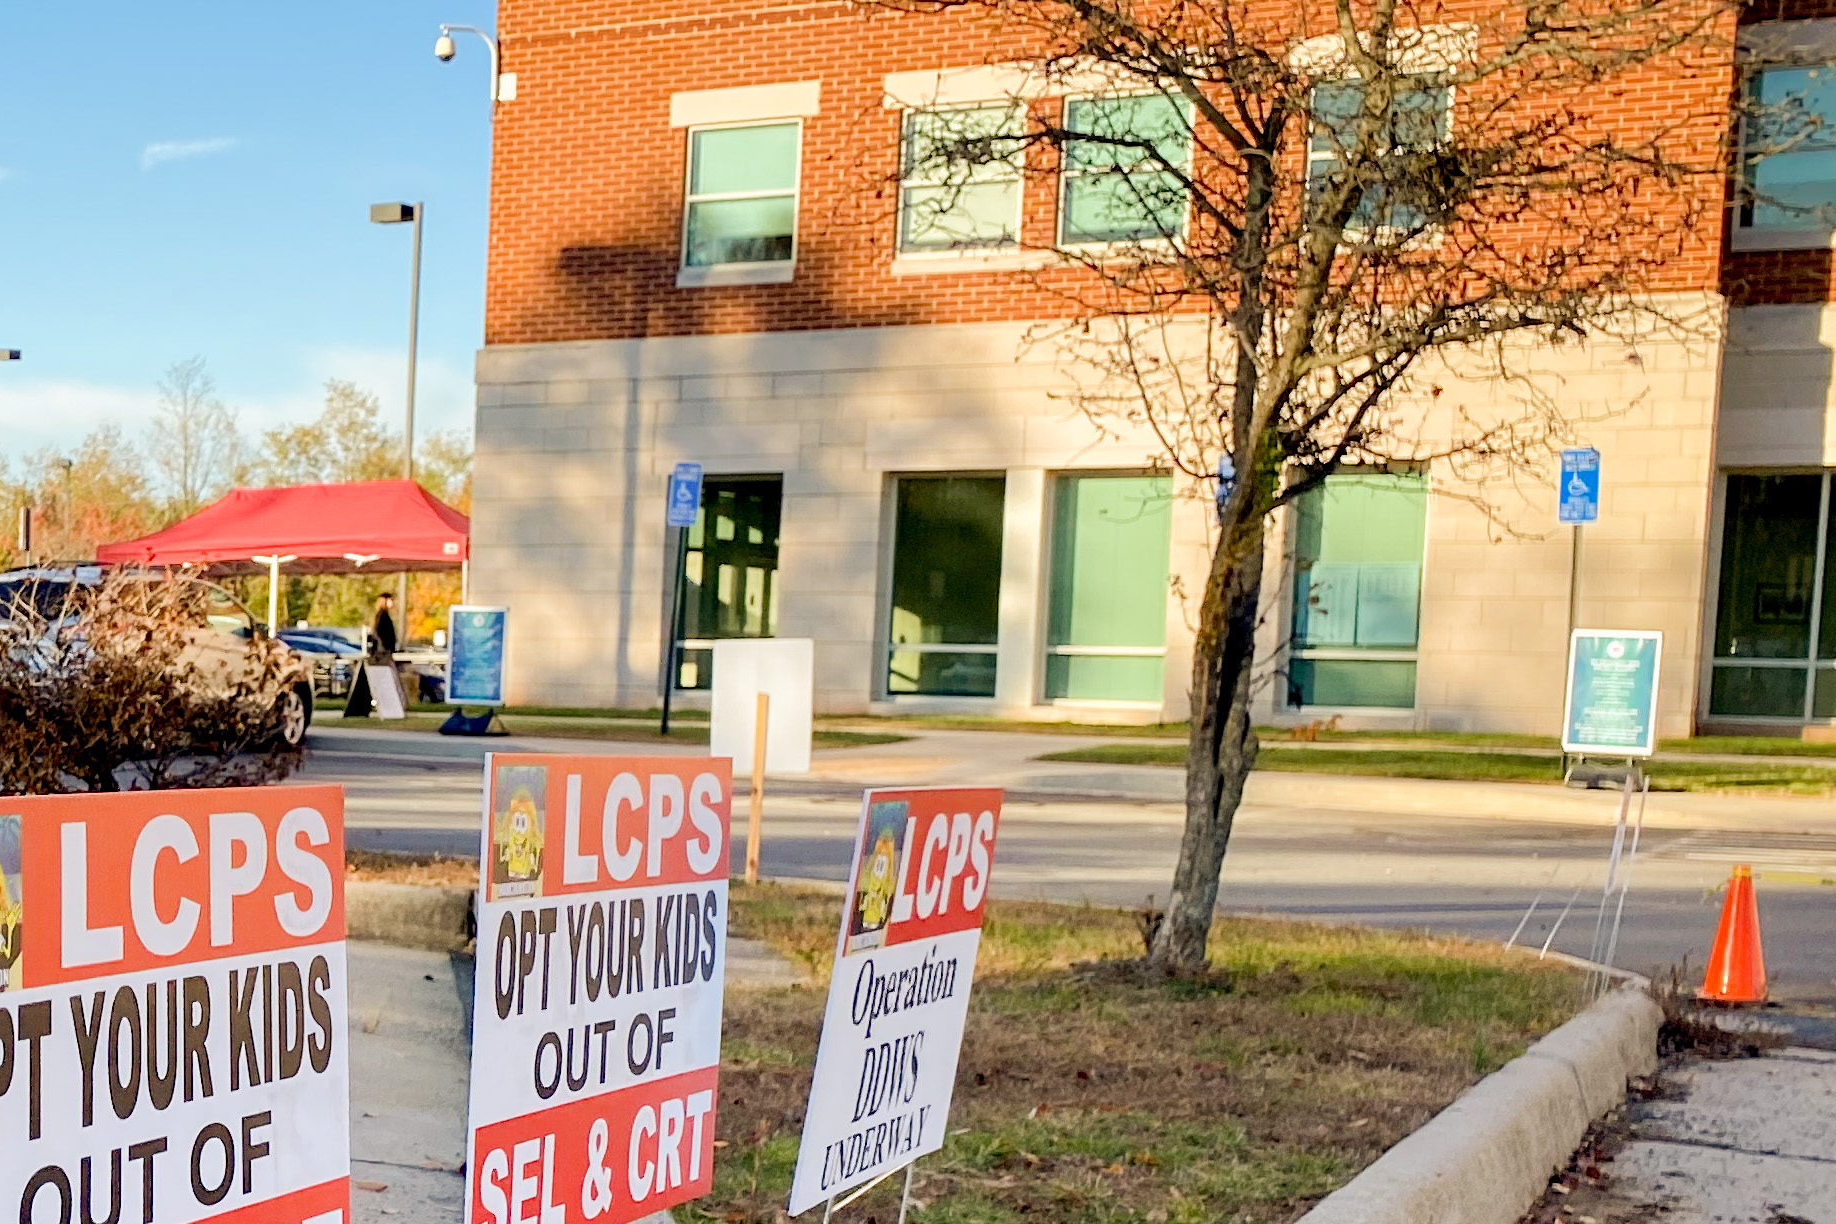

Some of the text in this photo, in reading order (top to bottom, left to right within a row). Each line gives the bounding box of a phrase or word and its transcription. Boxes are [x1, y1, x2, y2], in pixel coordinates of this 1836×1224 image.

[563, 772, 723, 886] LCPS
[891, 809, 994, 923] LCPS
[60, 806, 334, 969] LCPS
[495, 889, 718, 1021] OPT YOUR KIDS
[851, 943, 958, 1040] Operation
[69, 974, 213, 1128] YOUR
[228, 954, 332, 1091] KIDS
[534, 1007, 677, 1100] OUT OF
[851, 1030, 924, 1124] DDWS
[190, 1110, 272, 1207] OF
[581, 1117, 613, 1220] &
[627, 1089, 712, 1204] CRT
[820, 1104, 931, 1192] UNDERWAY
